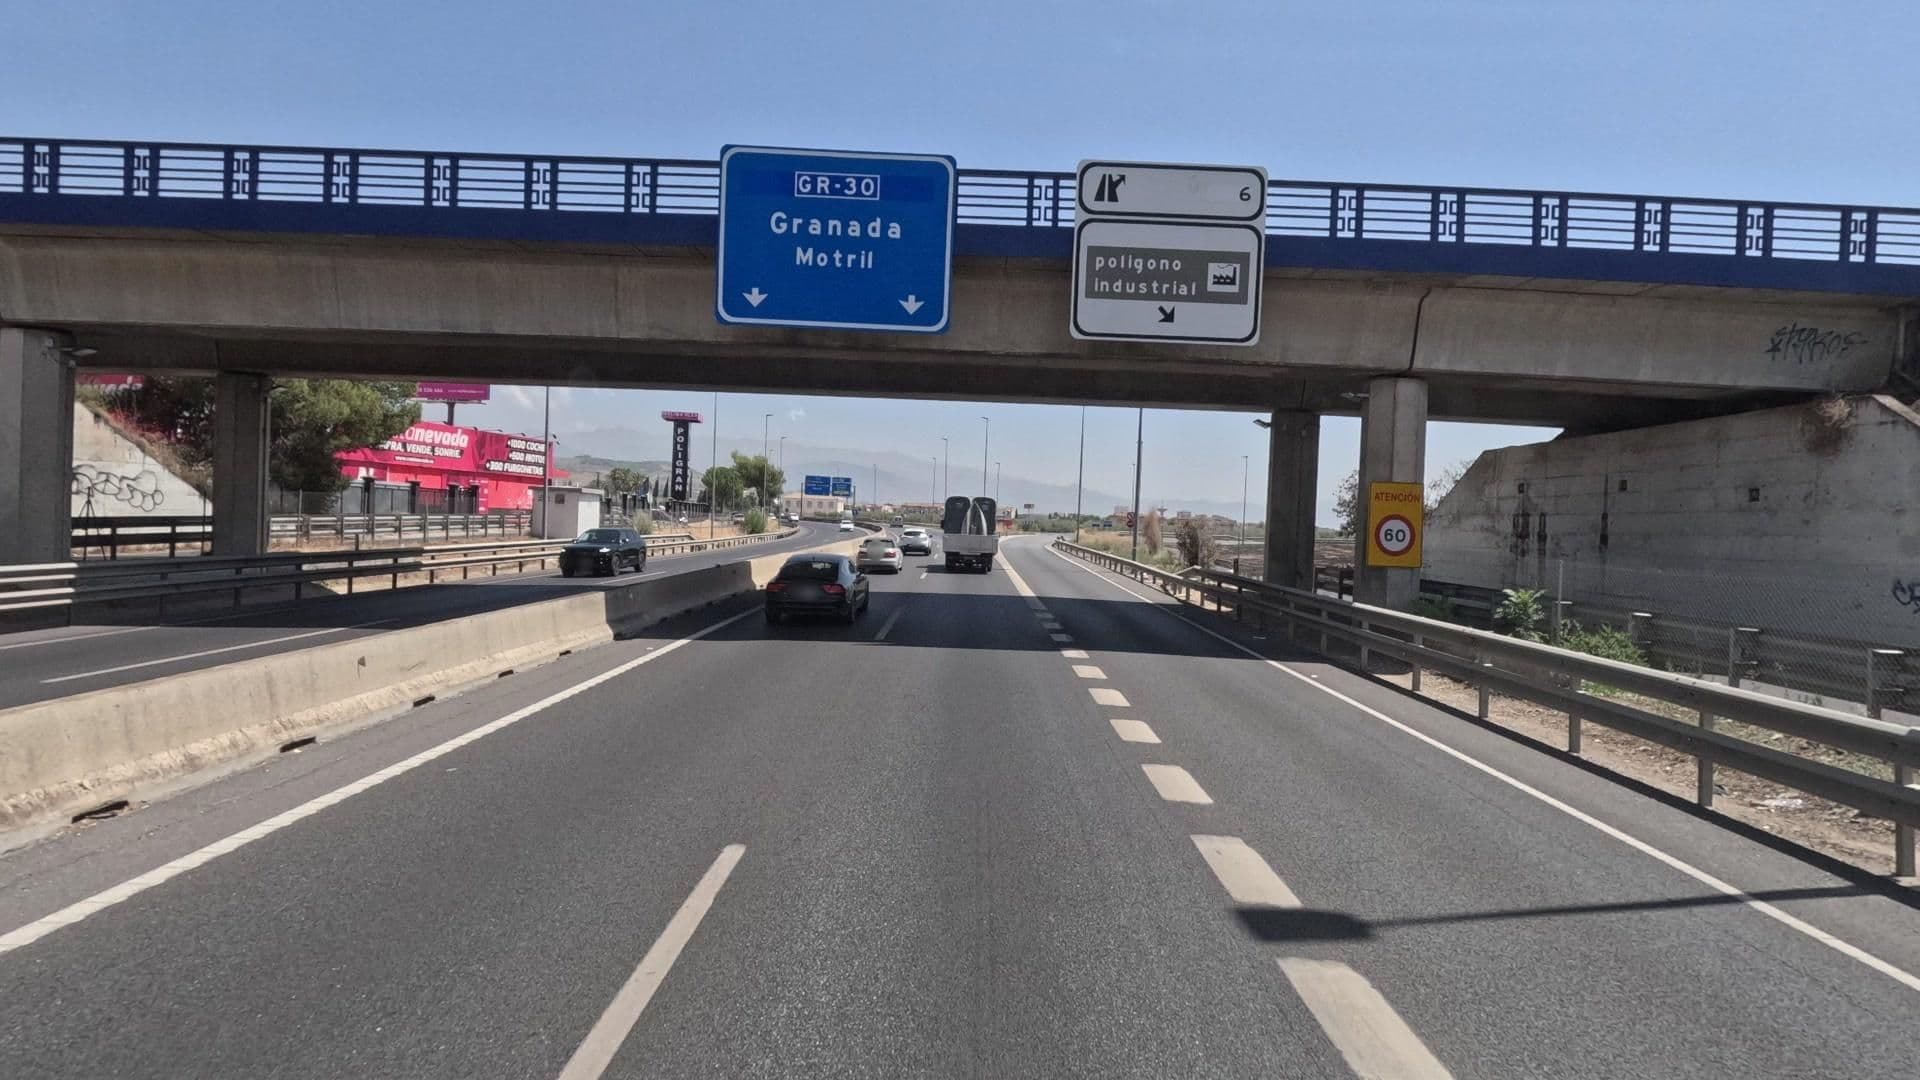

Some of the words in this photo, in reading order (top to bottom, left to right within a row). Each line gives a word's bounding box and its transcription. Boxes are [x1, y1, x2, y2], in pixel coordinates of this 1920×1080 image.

[798, 175, 875, 196] GR-30
[1239, 186, 1252, 202] 6
[770, 211, 901, 239] Granada
[796, 246, 873, 269] Motril
[1094, 278, 1196, 296] industrial
[675, 427, 685, 492] POLIGRAN
[1384, 528, 1406, 542] 60
